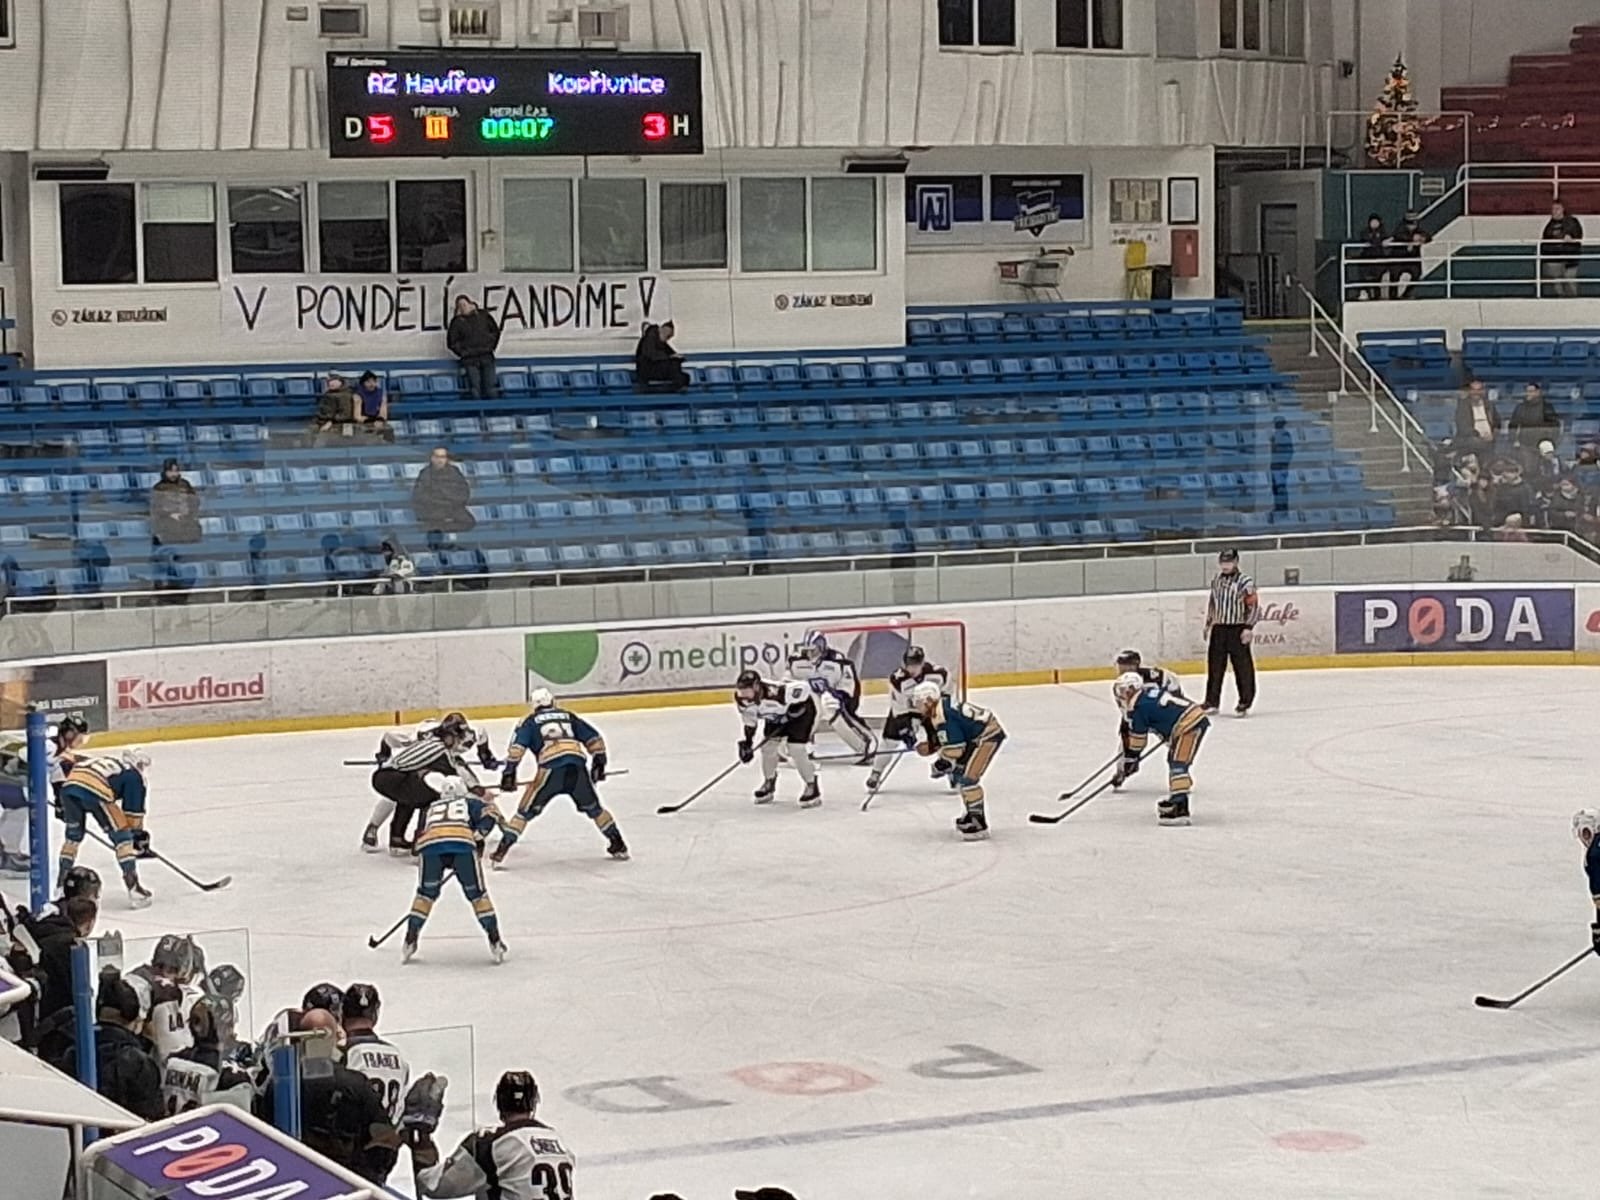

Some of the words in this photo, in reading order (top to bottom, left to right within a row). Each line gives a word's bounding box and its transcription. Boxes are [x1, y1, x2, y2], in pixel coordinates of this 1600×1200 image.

[367, 71, 398, 95] AZ
[345, 117, 363, 138] D
[368, 115, 393, 140] 5
[481, 117, 553, 139] 00:07
[643, 114, 667, 139] 3
[673, 115, 690, 136] H
[233, 286, 267, 331] V
[297, 275, 454, 332] PONDĚLÍ
[483, 275, 629, 331] FANDÍME
[1256, 602, 1299, 626] Cafe
[1254, 634, 1286, 644] RAVA
[659, 632, 804, 674] medipoi
[146, 672, 265, 703] Kaufland
